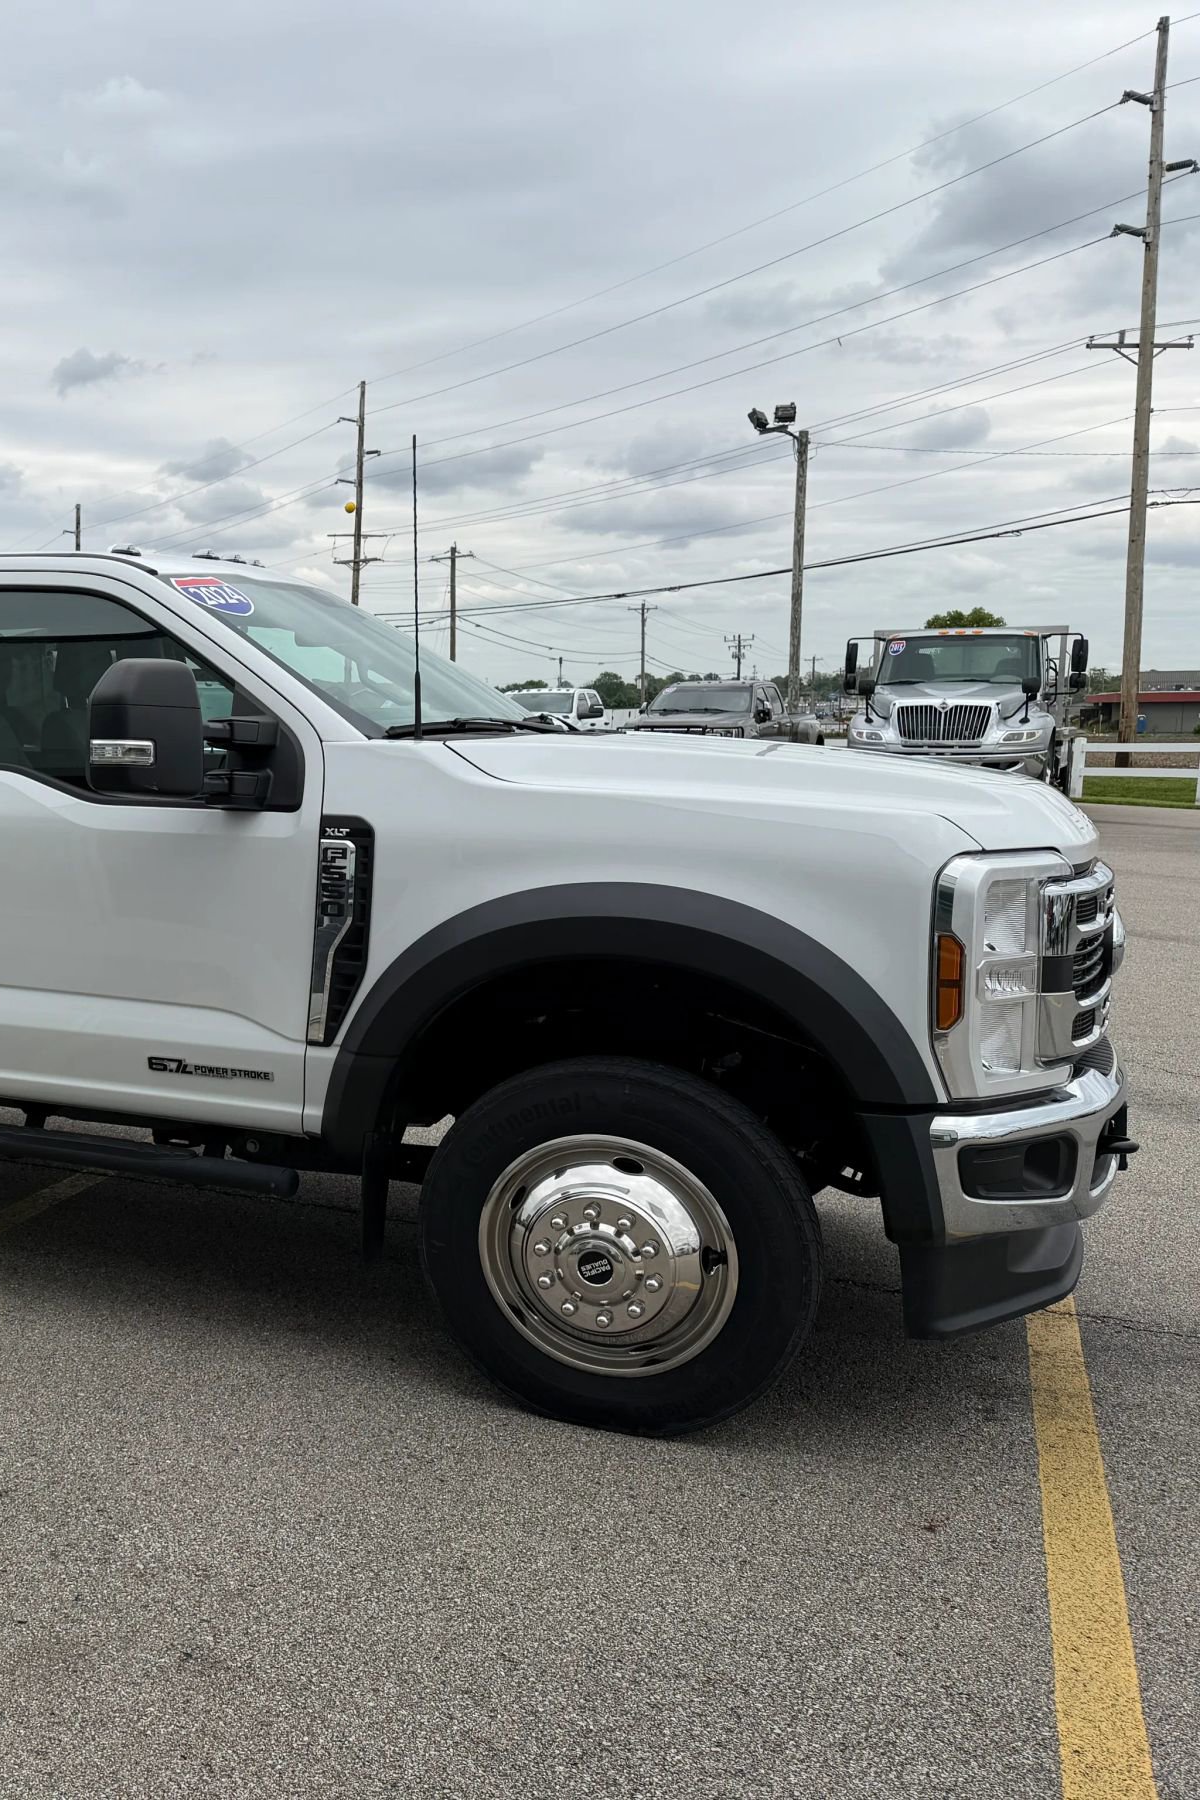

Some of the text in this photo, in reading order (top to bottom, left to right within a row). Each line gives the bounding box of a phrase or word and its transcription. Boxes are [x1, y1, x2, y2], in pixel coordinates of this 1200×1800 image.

[187, 585, 249, 606] 2024
[324, 827, 351, 836] XLT
[147, 1056, 193, 1075] 6.7L
[193, 1064, 229, 1076] POWER
[230, 1068, 270, 1081] STROKE
[580, 1258, 609, 1272] DUALIES
[582, 1264, 611, 1278] PACIFIC
